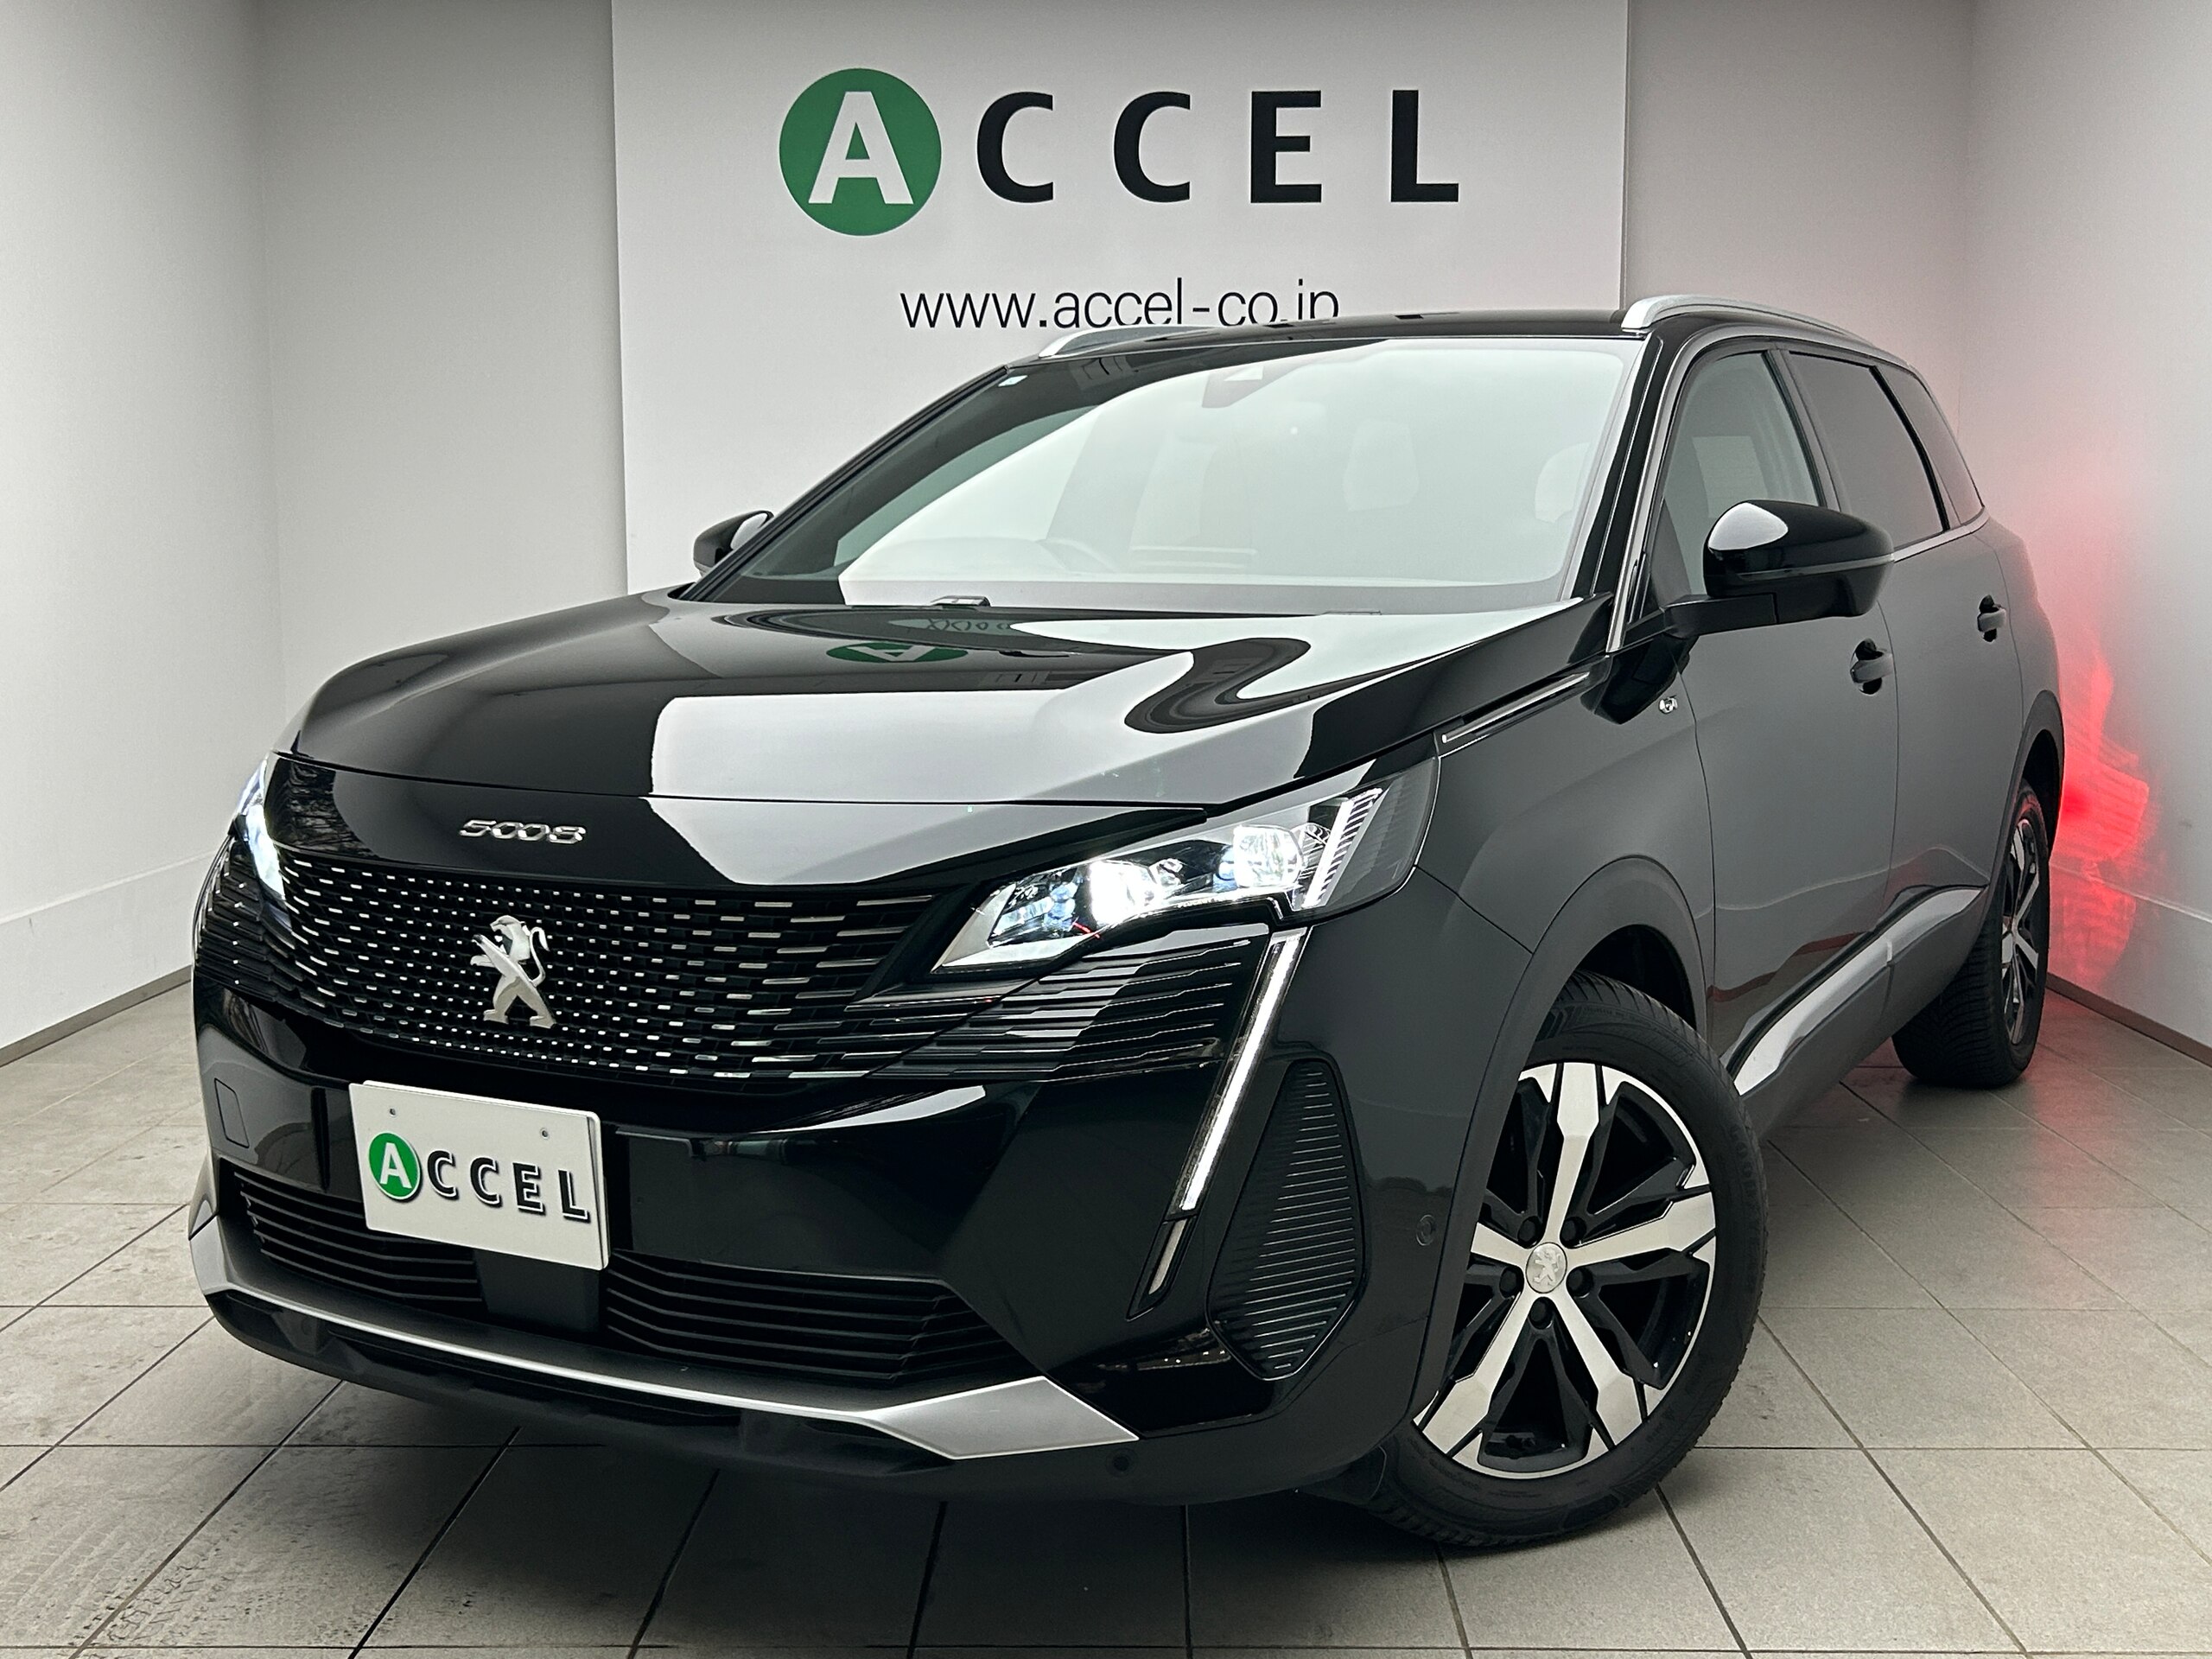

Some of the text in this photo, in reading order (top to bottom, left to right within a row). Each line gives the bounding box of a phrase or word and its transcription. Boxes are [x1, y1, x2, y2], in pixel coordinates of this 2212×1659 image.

[808, 89, 1459, 204] ACCEL
[459, 819, 587, 844] 5008
[378, 1141, 591, 1224] ACCEL
